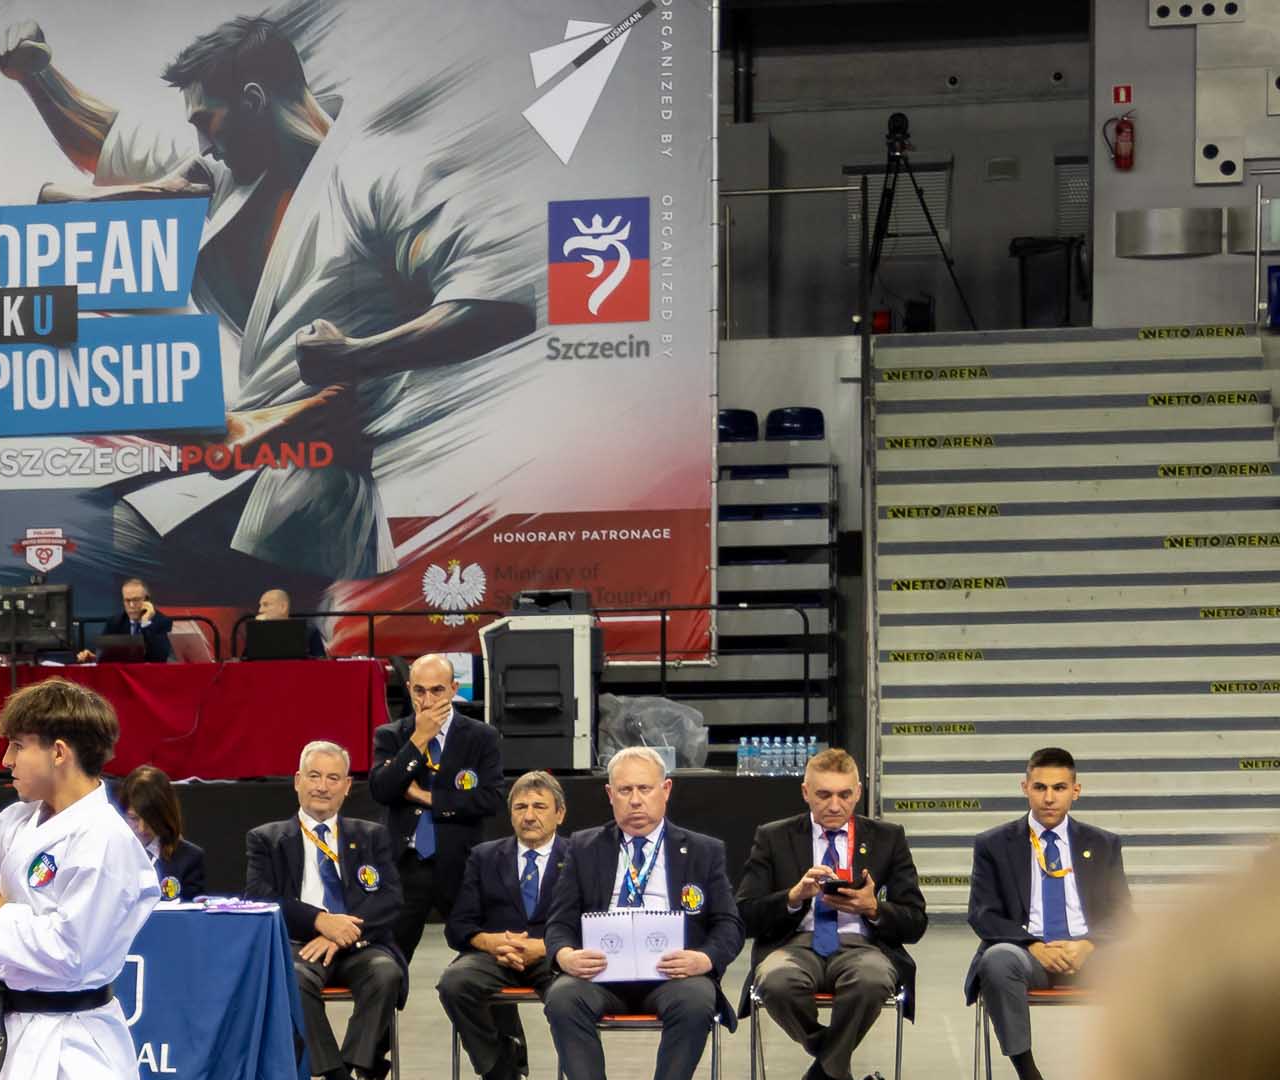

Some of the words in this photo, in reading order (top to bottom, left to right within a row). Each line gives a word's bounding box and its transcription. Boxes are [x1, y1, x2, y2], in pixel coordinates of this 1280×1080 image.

[660, 133, 673, 158] BY
[660, 194, 673, 321] ORGANIZED
[1147, 328, 1191, 339] NETTO
[1195, 327, 1246, 337] ARENA
[545, 334, 651, 361] Szczecin
[660, 334, 673, 359] BY
[890, 370, 934, 380] NETTO
[939, 367, 988, 378] ARENA
[1157, 395, 1202, 405] NETTO
[1206, 393, 1258, 404] ARENA
[893, 438, 938, 448] NETTO
[942, 437, 994, 448] ARENA
[1166, 465, 1212, 476] NETTO
[1217, 464, 1271, 475] ARENA
[896, 507, 941, 518] NETTO
[946, 505, 999, 516] ARENA
[493, 531, 576, 543] HONORARY
[582, 528, 671, 541] PATRONAGE
[1174, 536, 1220, 547] NETTO
[1226, 535, 1280, 546] ARENA
[901, 579, 947, 591] NETTO
[952, 578, 1007, 589] ARENA
[939, 651, 983, 660] ARENA
[936, 723, 976, 732] ARENA
